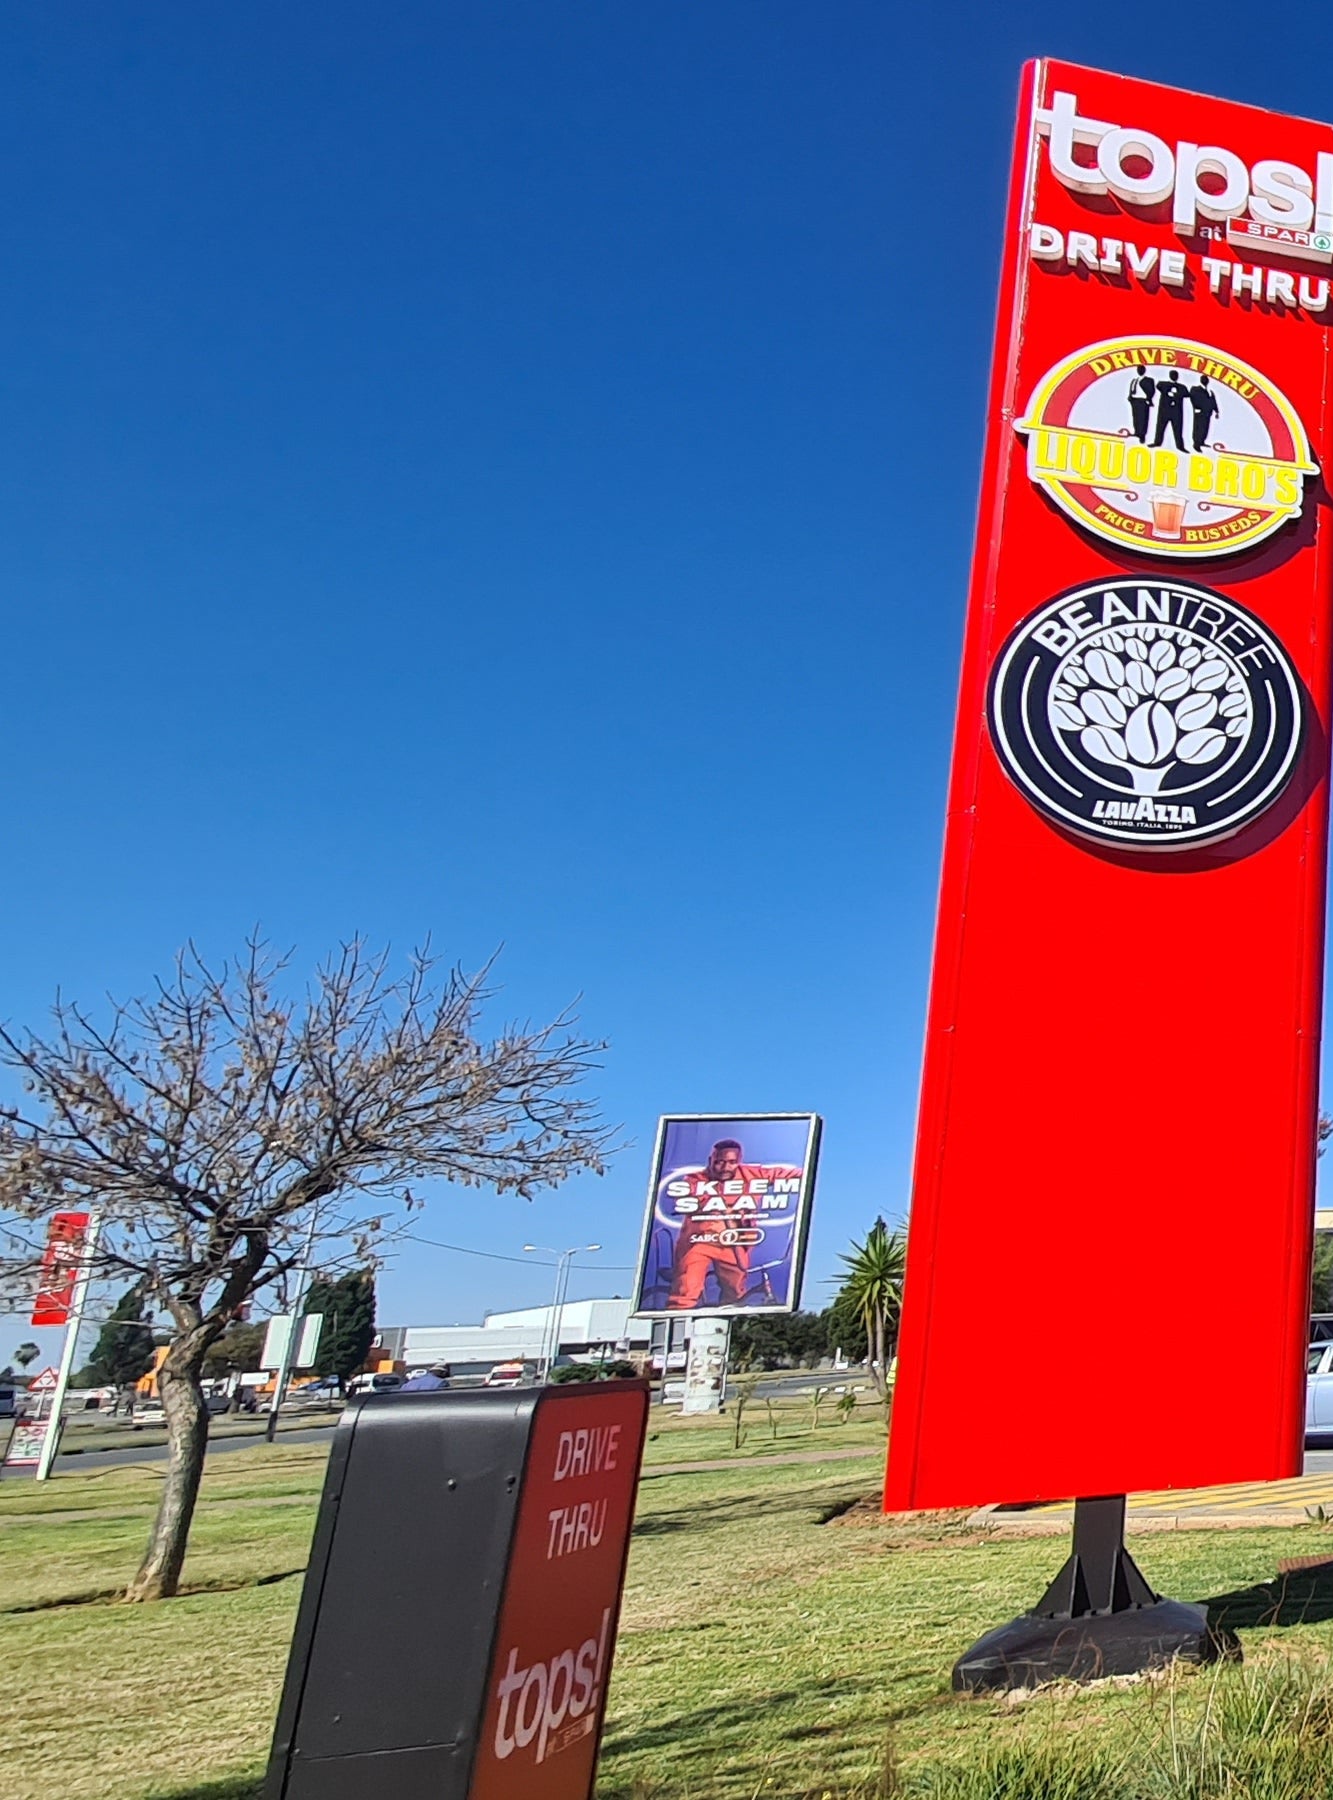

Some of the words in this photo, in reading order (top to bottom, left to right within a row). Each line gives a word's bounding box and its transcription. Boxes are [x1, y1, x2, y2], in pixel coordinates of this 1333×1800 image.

[1200, 226, 1222, 242] at
[1247, 223, 1310, 247] SPAR
[1030, 223, 1186, 287] DRIVE
[1202, 256, 1330, 312] THRU
[1088, 348, 1177, 377] DRIVE
[1187, 352, 1260, 402] THRU
[1035, 430, 1179, 488] LIQUOR
[1188, 453, 1299, 505] BRO'S
[1094, 504, 1146, 535] PRICE
[1185, 512, 1262, 542] BUSTEDS
[1092, 797, 1197, 824] LAVAZZA
[667, 1178, 801, 1198] SKEEM
[674, 1195, 788, 1213] SAAM
[553, 1424, 622, 1482] DRIVE
[547, 1498, 607, 1560] THRU
[494, 1608, 611, 1765] tops!
